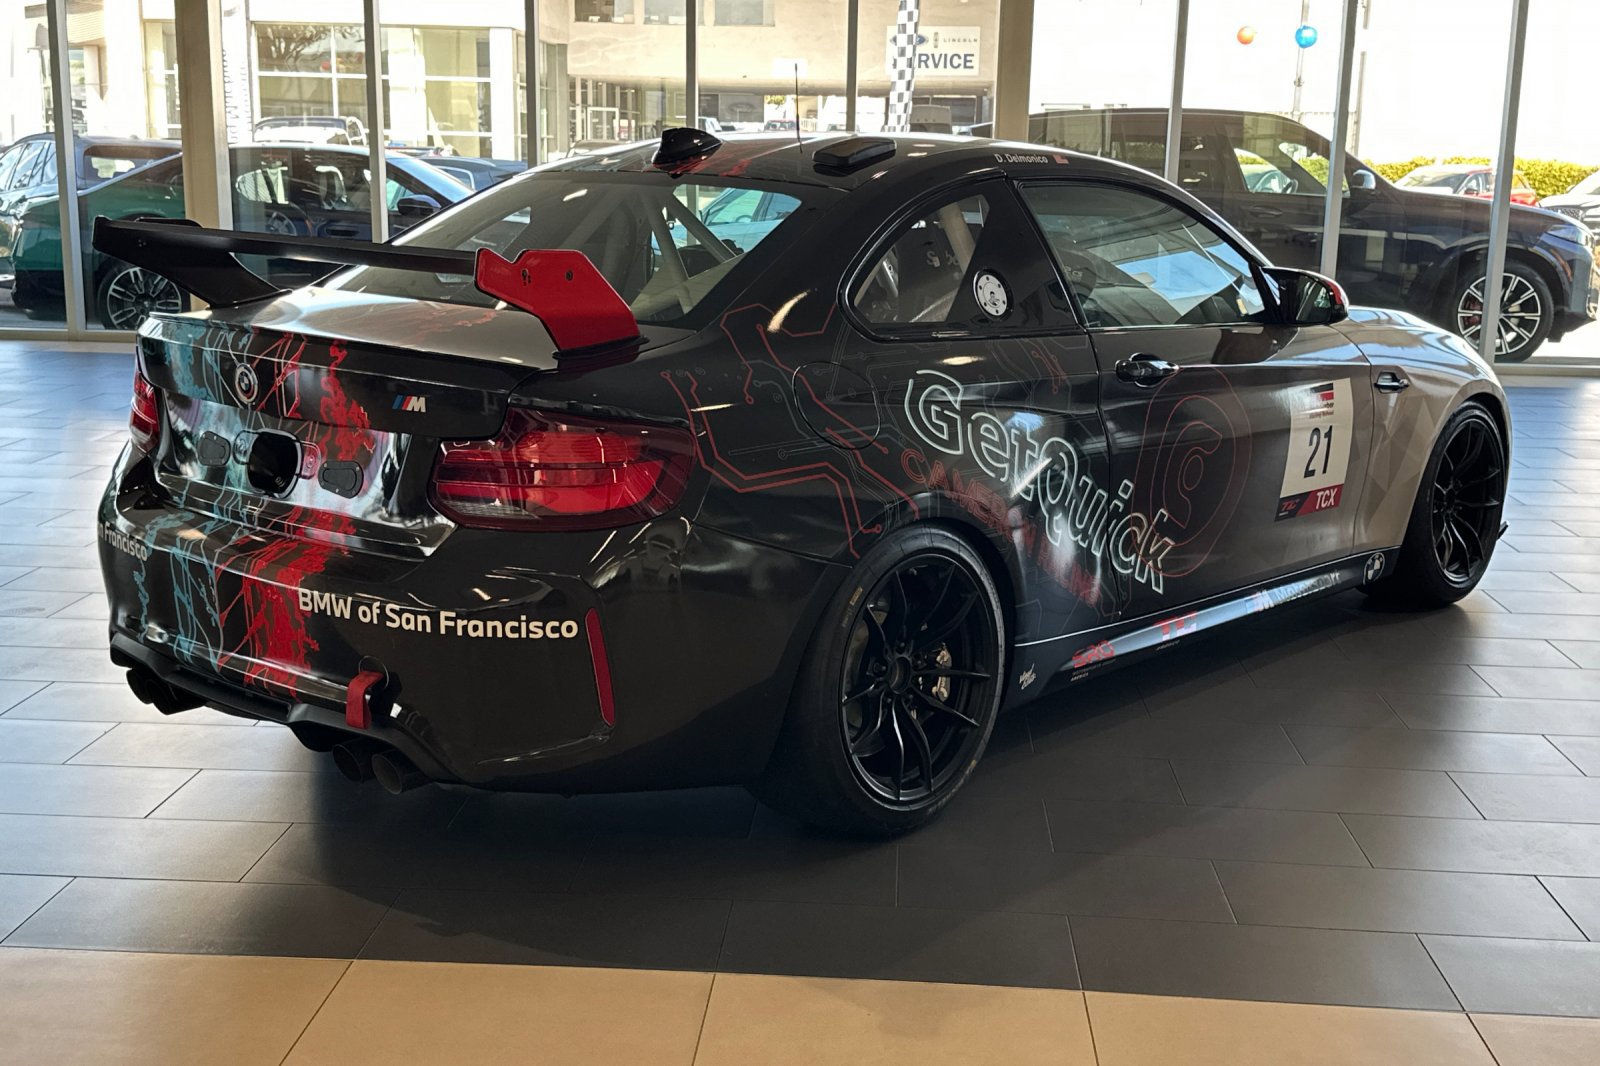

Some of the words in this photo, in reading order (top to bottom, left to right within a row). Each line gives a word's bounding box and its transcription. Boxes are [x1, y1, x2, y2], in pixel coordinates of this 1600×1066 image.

[893, 53, 975, 69] RVICE
[1005, 153, 1049, 164] Delmonico
[1303, 425, 1333, 479] 21
[1315, 487, 1338, 510] TCX
[105, 521, 148, 562] Francisco
[298, 588, 352, 620] BMW
[358, 601, 381, 624] of
[385, 604, 432, 633] San
[440, 611, 578, 639] Francisco
